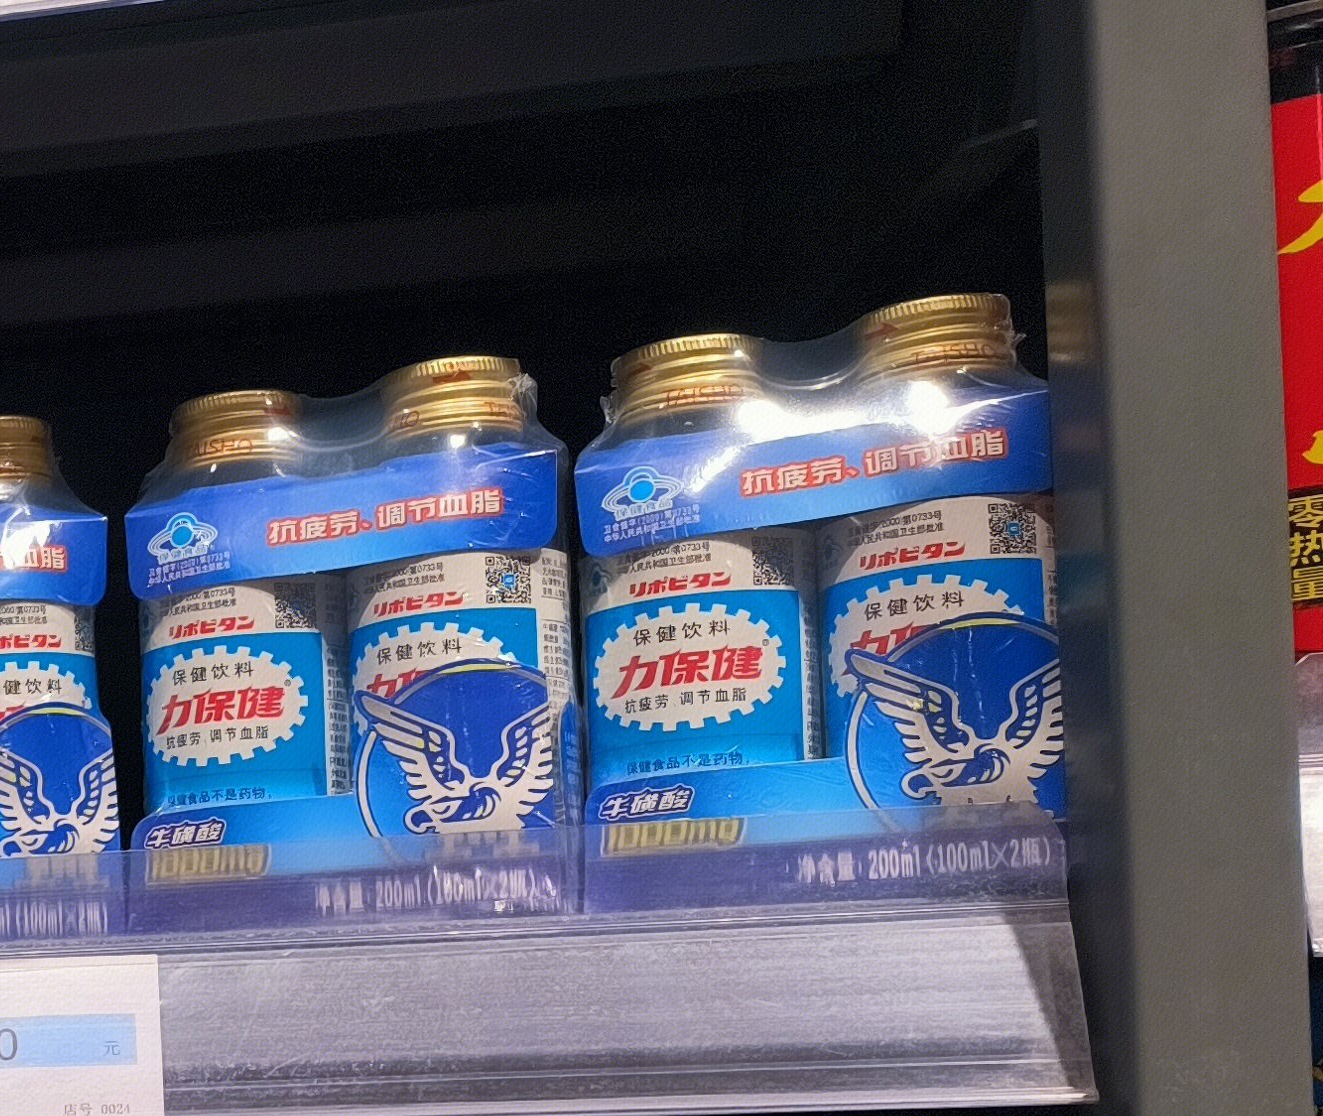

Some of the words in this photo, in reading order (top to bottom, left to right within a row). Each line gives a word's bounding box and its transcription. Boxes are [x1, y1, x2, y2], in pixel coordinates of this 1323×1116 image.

[268, 489, 504, 546] 抗疲劳、调节血脂
[859, 540, 966, 570] リポビタン
[629, 571, 732, 598] リポビタン
[373, 591, 464, 616] リポビタン
[863, 590, 965, 619] 保健饮料
[168, 615, 255, 639] リポビタン
[632, 619, 730, 646] 保健饮料
[376, 637, 462, 665] 保健饮料
[172, 660, 255, 686] 保健饮料
[612, 643, 765, 700] 力保健
[157, 685, 288, 735] 力保健
[601, 787, 692, 820] 牛磺酸
[103, 1040, 121, 1057] 元
[63, 1103, 93, 1116] 店号
[100, 1102, 131, 1115] 0024
